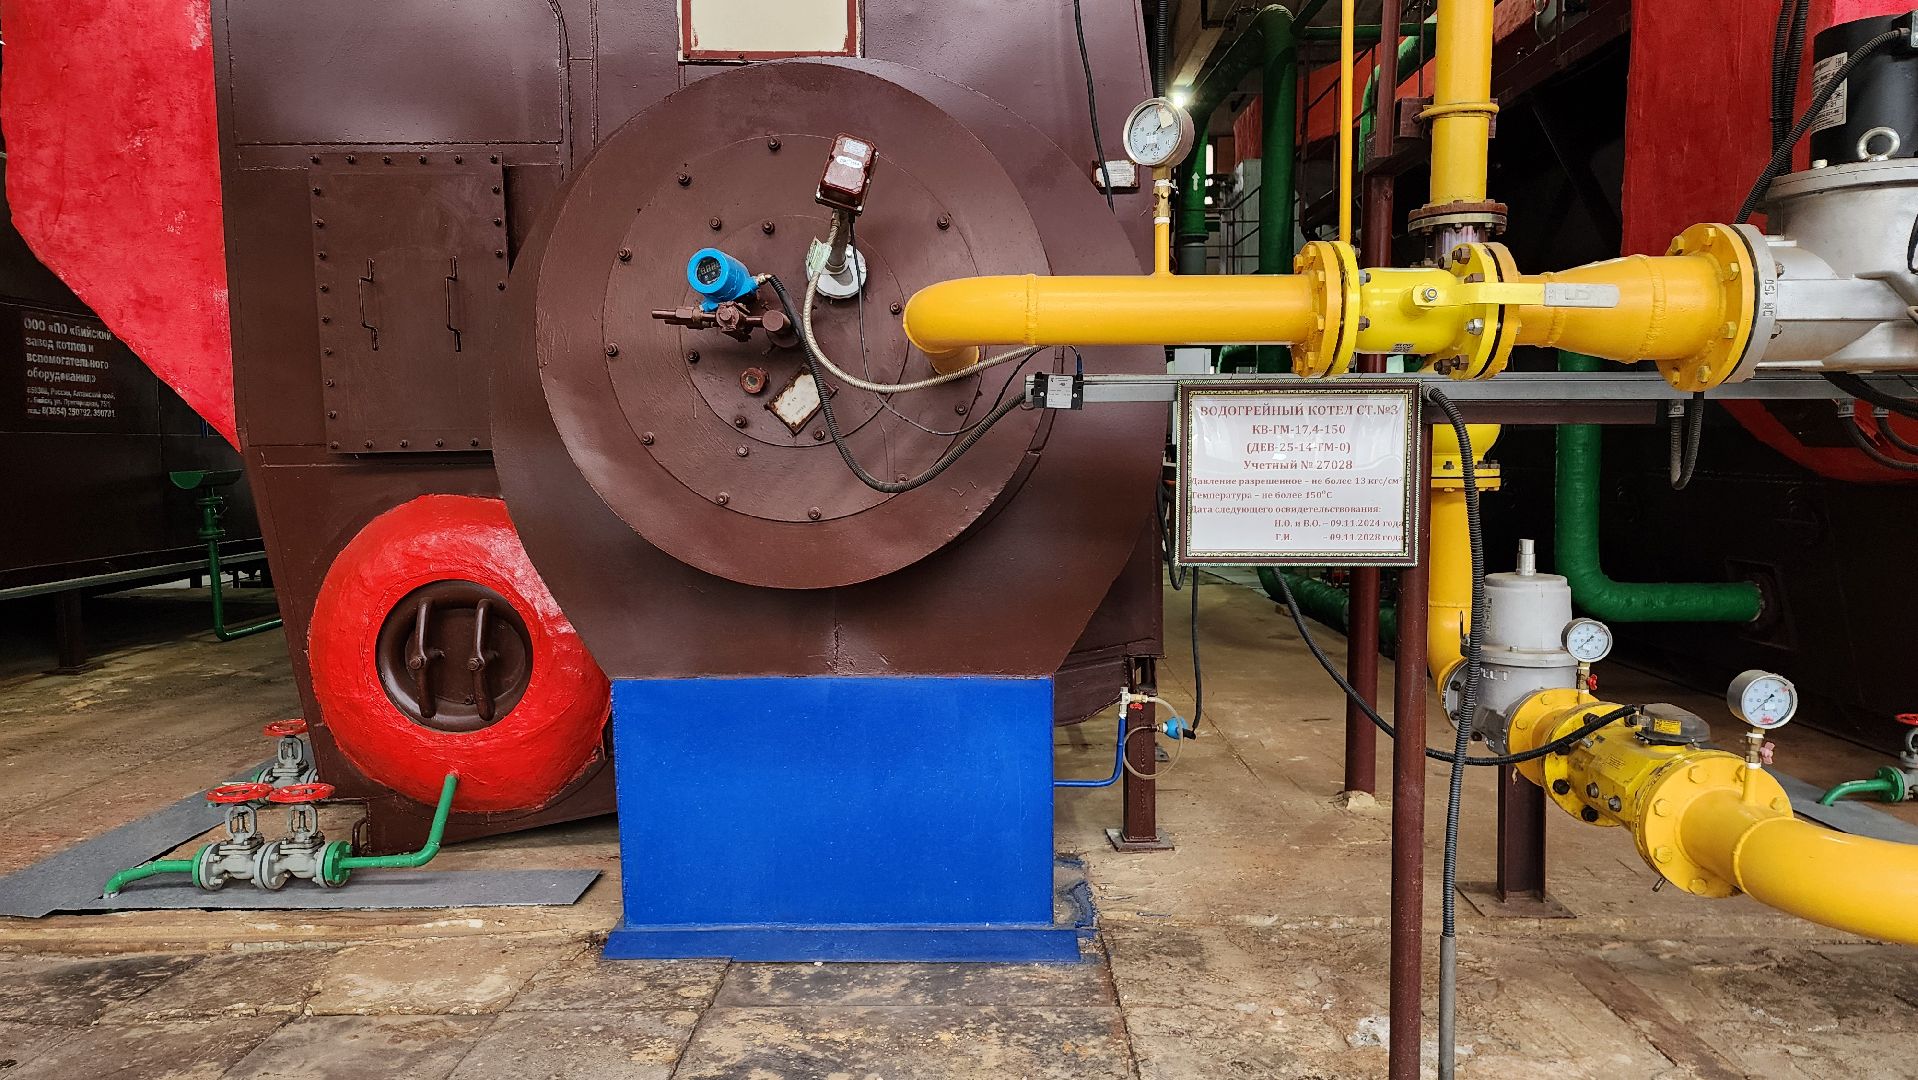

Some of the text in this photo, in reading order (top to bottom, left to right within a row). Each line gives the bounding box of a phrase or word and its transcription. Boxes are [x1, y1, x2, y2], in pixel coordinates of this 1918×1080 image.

[1764, 279, 1776, 296] 150
[24, 317, 46, 332] ООО
[48, 322, 68, 335] «ПО
[56, 340, 87, 353] котлов
[88, 344, 95, 353] и
[26, 352, 109, 370] вспомогательного
[27, 366, 97, 383] оборудования»
[1200, 402, 1398, 419] ВОДОГРЕЙНЫЙ КОТЕЛ СТ.№3
[1252, 424, 1346, 438] КВ-ГМ-17,4-150
[1246, 442, 1351, 455] (ДЕВ-25-14-ГМ-0)
[1243, 459, 1353, 471] Учетный № 27028
[1192, 477, 1237, 486] Давление
[1238, 478, 1303, 487] разрешенное
[1324, 477, 1352, 485] более
[1355, 477, 1366, 485] 13
[1192, 491, 1252, 501] Температура
[1274, 491, 1303, 499] более
[1192, 505, 1382, 515] Дата следующего освидетельствования:
[1303, 519, 1321, 528] В.О.
[1330, 519, 1380, 528] 09.11.2024
[1382, 520, 1404, 529] года
[1275, 533, 1293, 541] Г.И.
[1329, 533, 1381, 541] 09.11.2028
[1382, 534, 1404, 542] года
